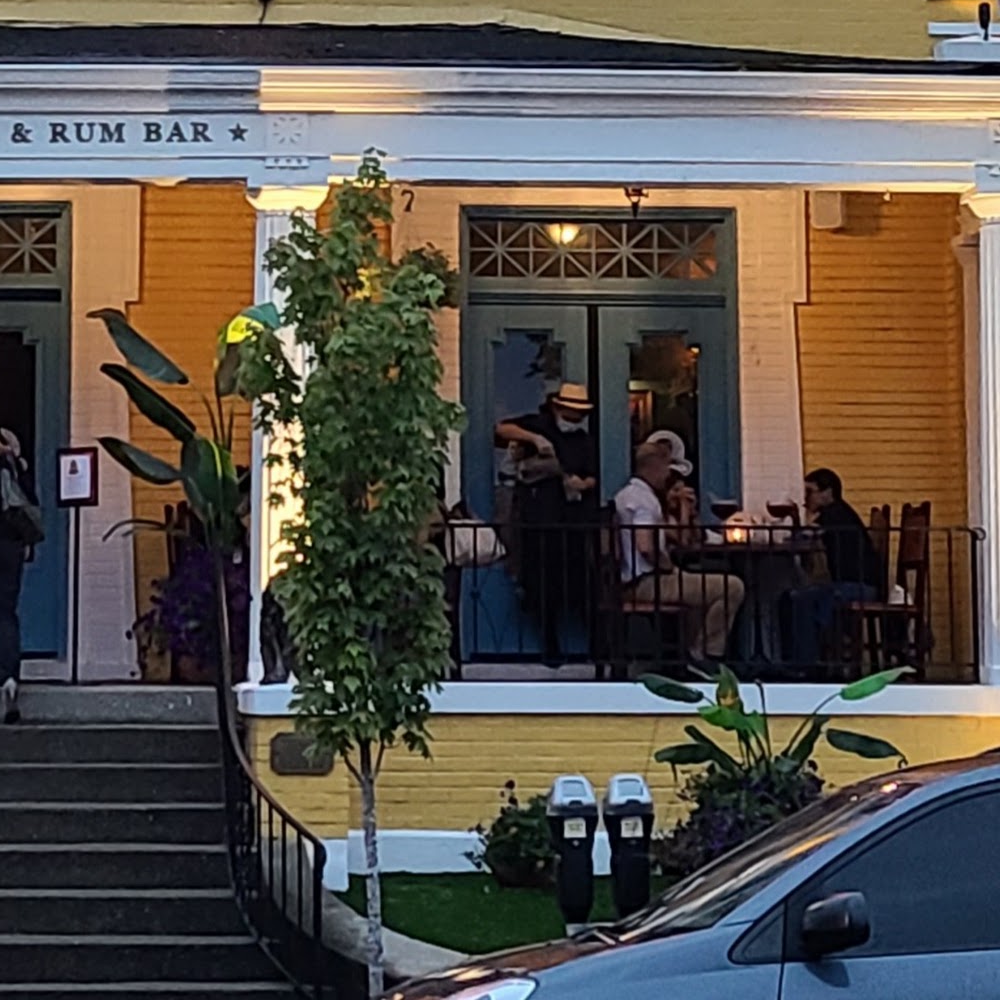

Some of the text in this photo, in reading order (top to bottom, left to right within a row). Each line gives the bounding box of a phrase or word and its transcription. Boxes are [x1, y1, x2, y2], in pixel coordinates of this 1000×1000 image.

[11, 122, 33, 143] &
[49, 122, 126, 143] RUM
[142, 122, 213, 143] BAR
